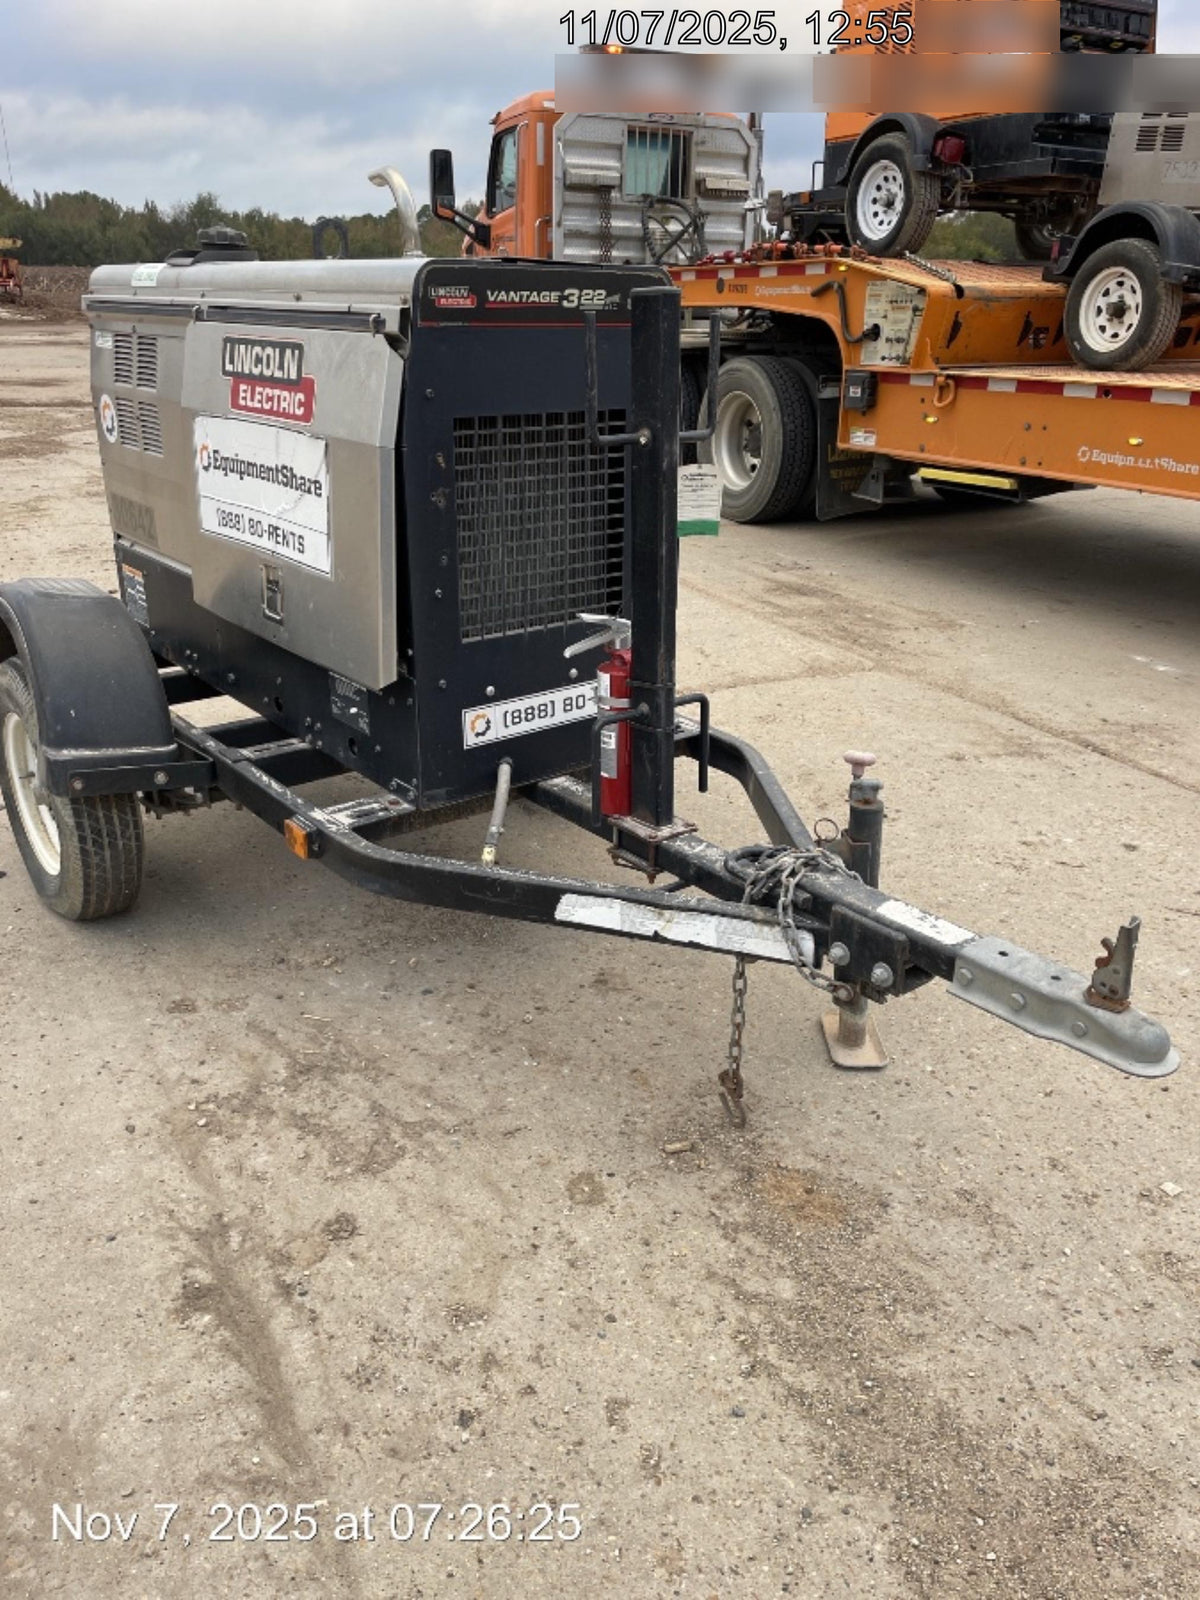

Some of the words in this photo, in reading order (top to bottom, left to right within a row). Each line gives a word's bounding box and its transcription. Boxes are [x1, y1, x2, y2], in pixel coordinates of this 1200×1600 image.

[486, 289, 561, 303] VANTAGE
[561, 288, 607, 308] 322
[225, 342, 300, 380] LINCOLN
[238, 383, 305, 416] ELECTRIC
[212, 449, 323, 498] EquipmentShare
[248, 517, 305, 554] 80-RENTS
[503, 699, 556, 729] (888)
